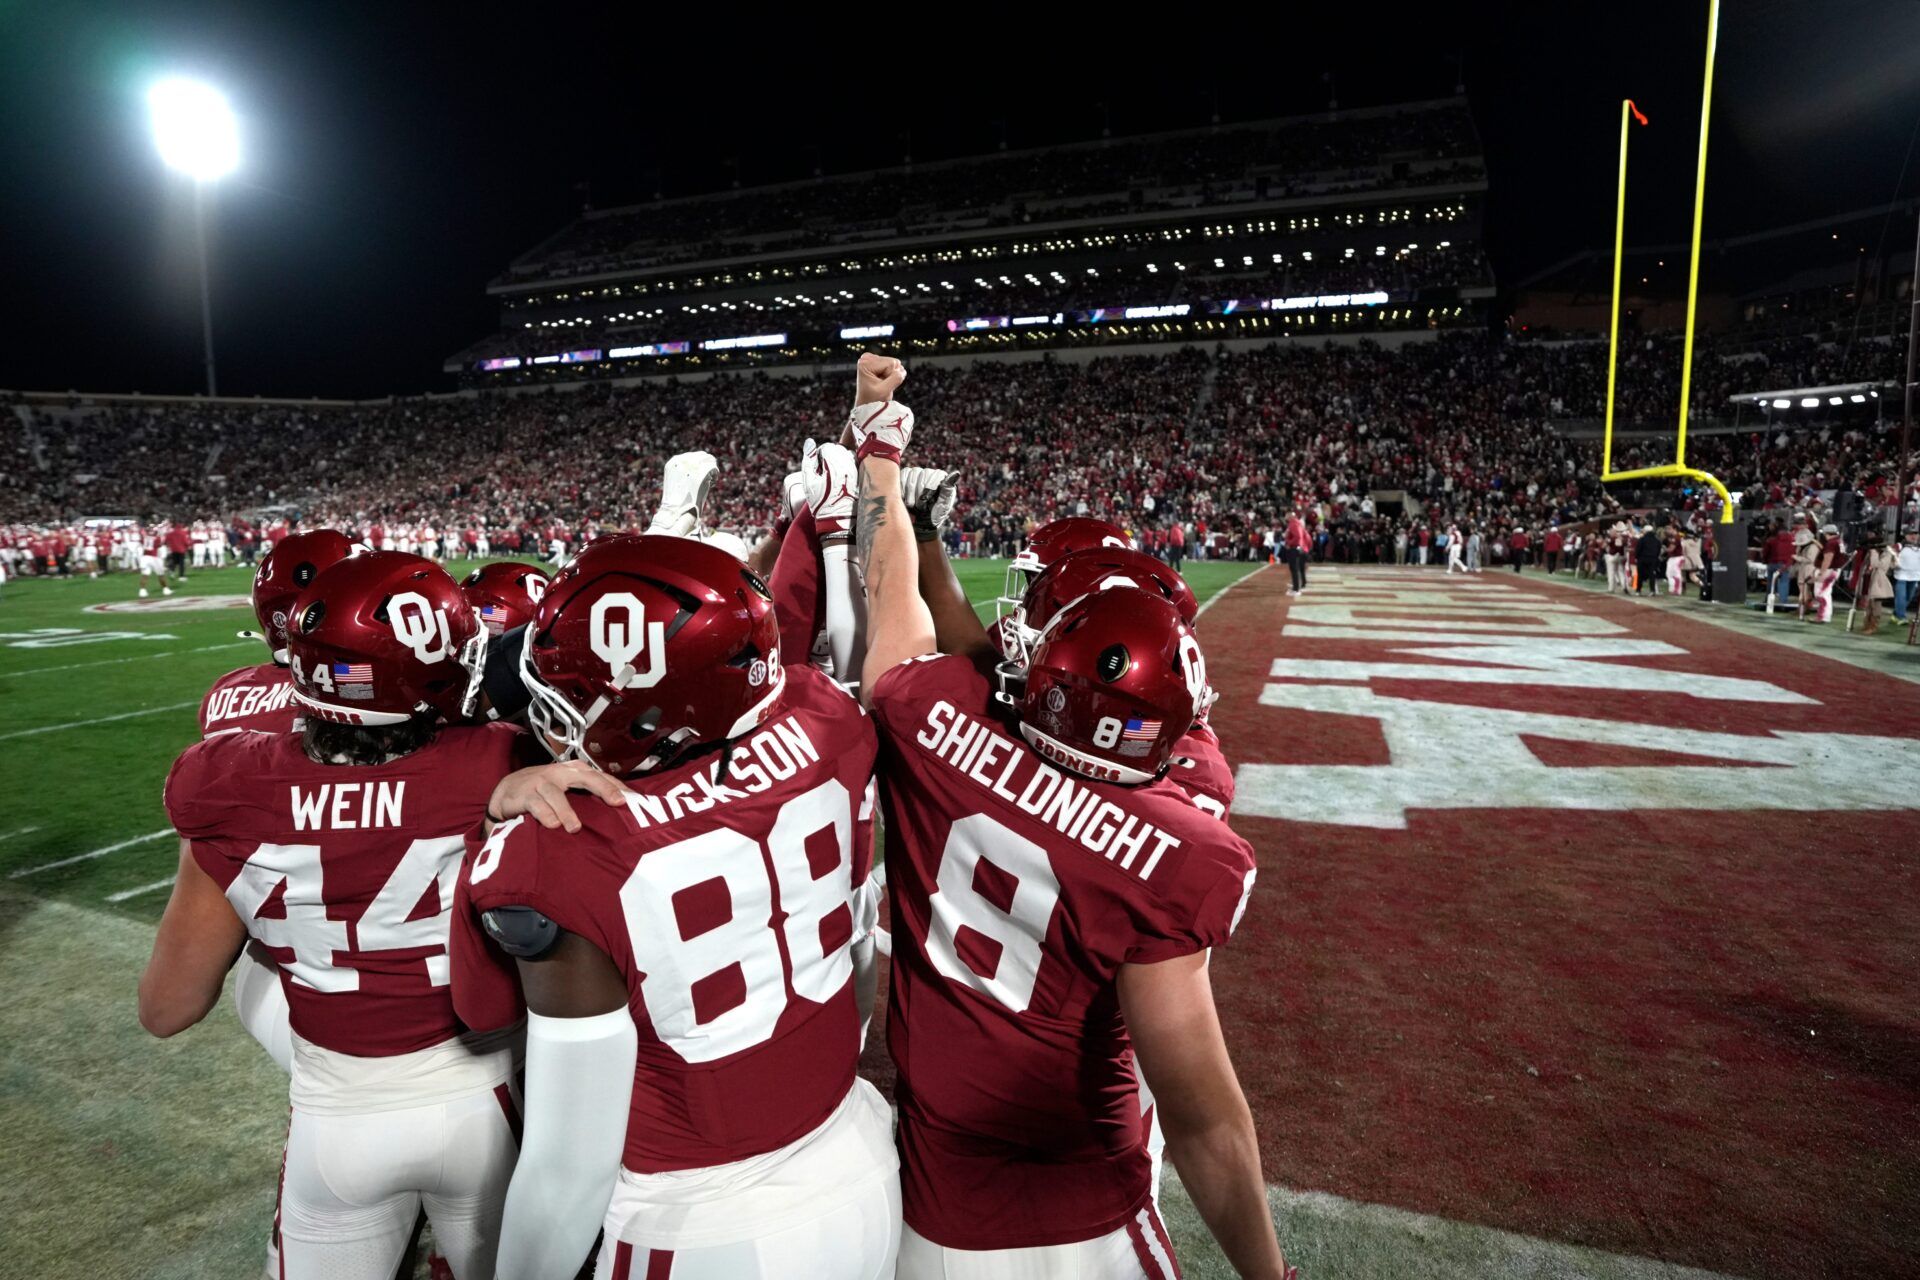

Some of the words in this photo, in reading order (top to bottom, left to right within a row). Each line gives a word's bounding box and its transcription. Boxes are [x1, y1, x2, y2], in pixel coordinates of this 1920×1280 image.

[386, 591, 458, 665] OU
[590, 592, 667, 689] OU
[291, 653, 335, 693] 44
[750, 662, 766, 685] SEC
[299, 701, 364, 725] NERS
[1092, 715, 1123, 750] 8
[620, 715, 820, 829] NICKSON
[916, 700, 1181, 881] SHIELDNIGHT
[1034, 737, 1121, 782] SOONERS
[290, 781, 405, 831] WEIN
[225, 833, 465, 993] 44
[619, 777, 854, 1064] 88
[924, 812, 1081, 1014] 8
